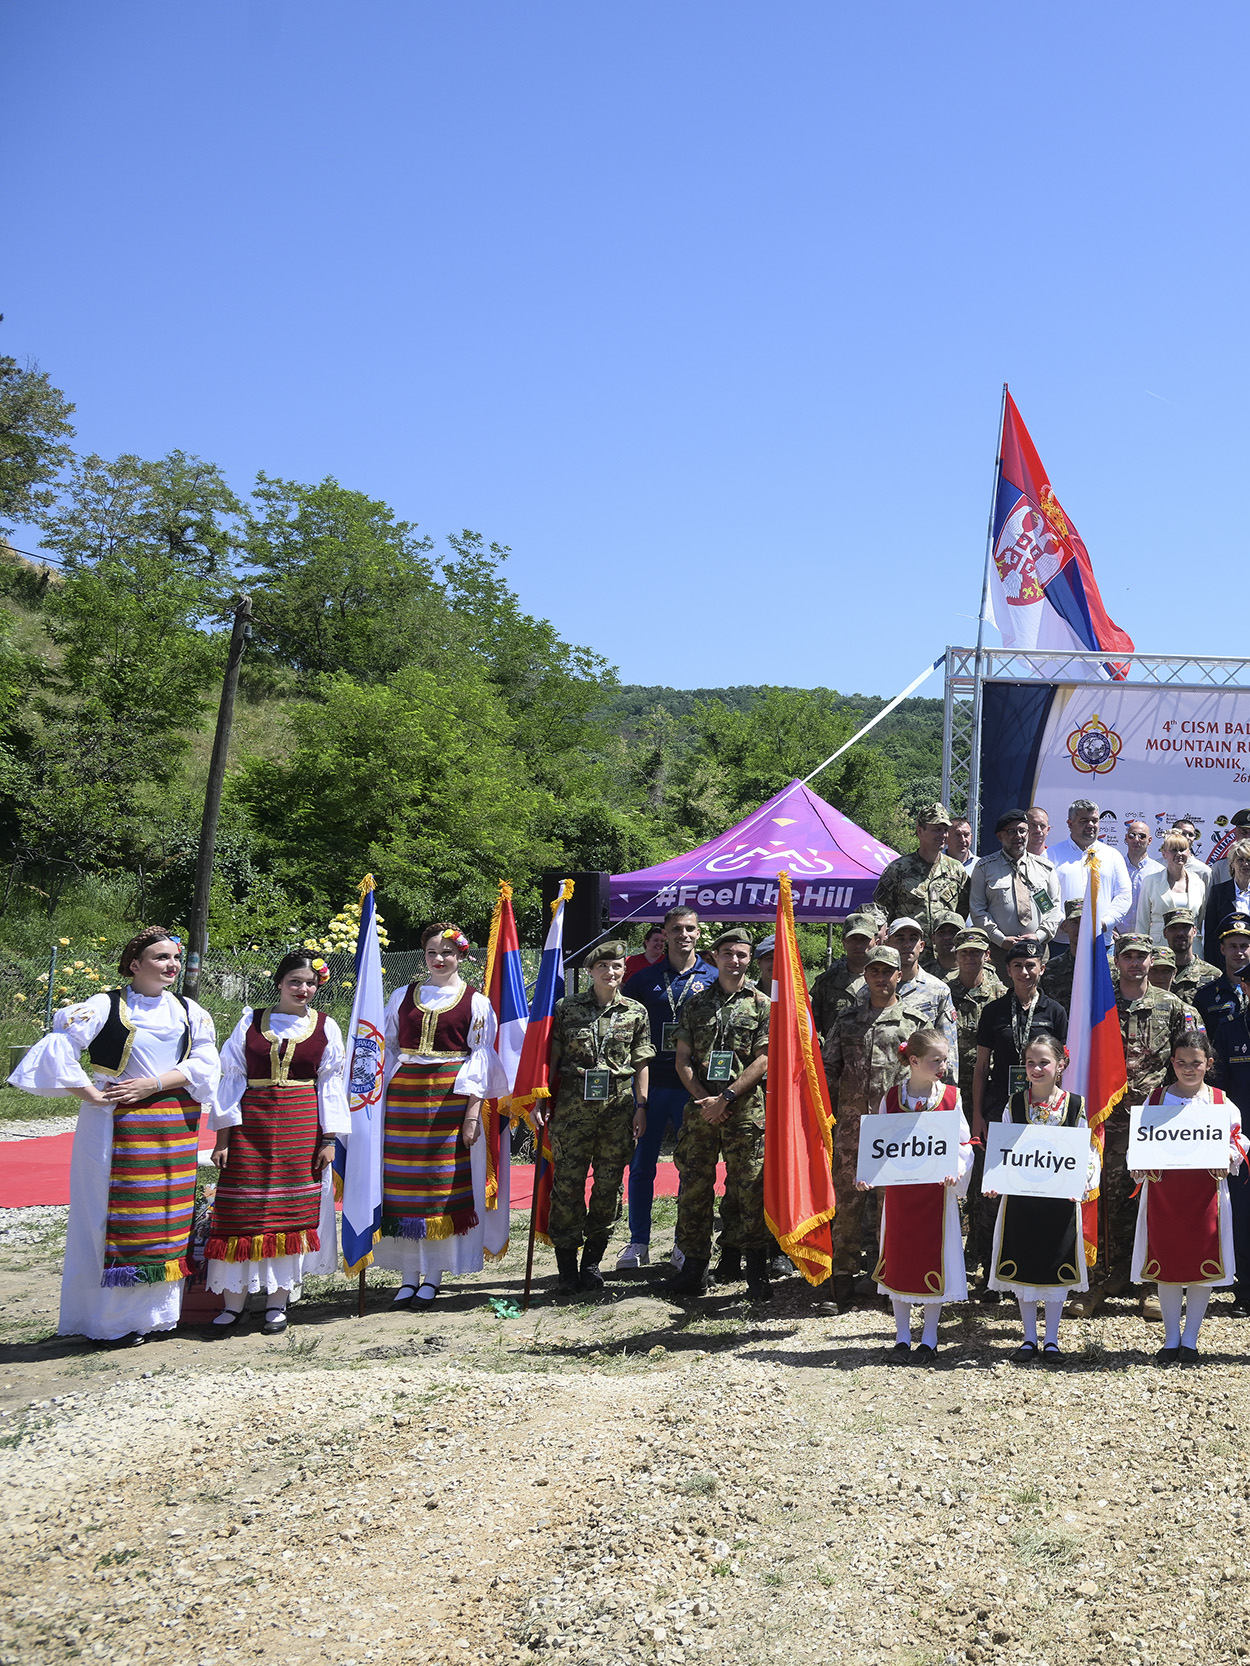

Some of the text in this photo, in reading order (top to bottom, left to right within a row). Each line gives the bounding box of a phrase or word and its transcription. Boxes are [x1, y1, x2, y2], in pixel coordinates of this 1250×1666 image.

[1180, 720, 1219, 734] CISM
[1145, 738, 1232, 753] MOUNTAIN
[1184, 756, 1246, 772] VRDNIK,
[1210, 831, 1237, 861] MILITAR
[1136, 1124, 1223, 1142] Slovenia
[871, 1135, 948, 1160] Serbia
[1000, 1148, 1077, 1174] Turkiye
